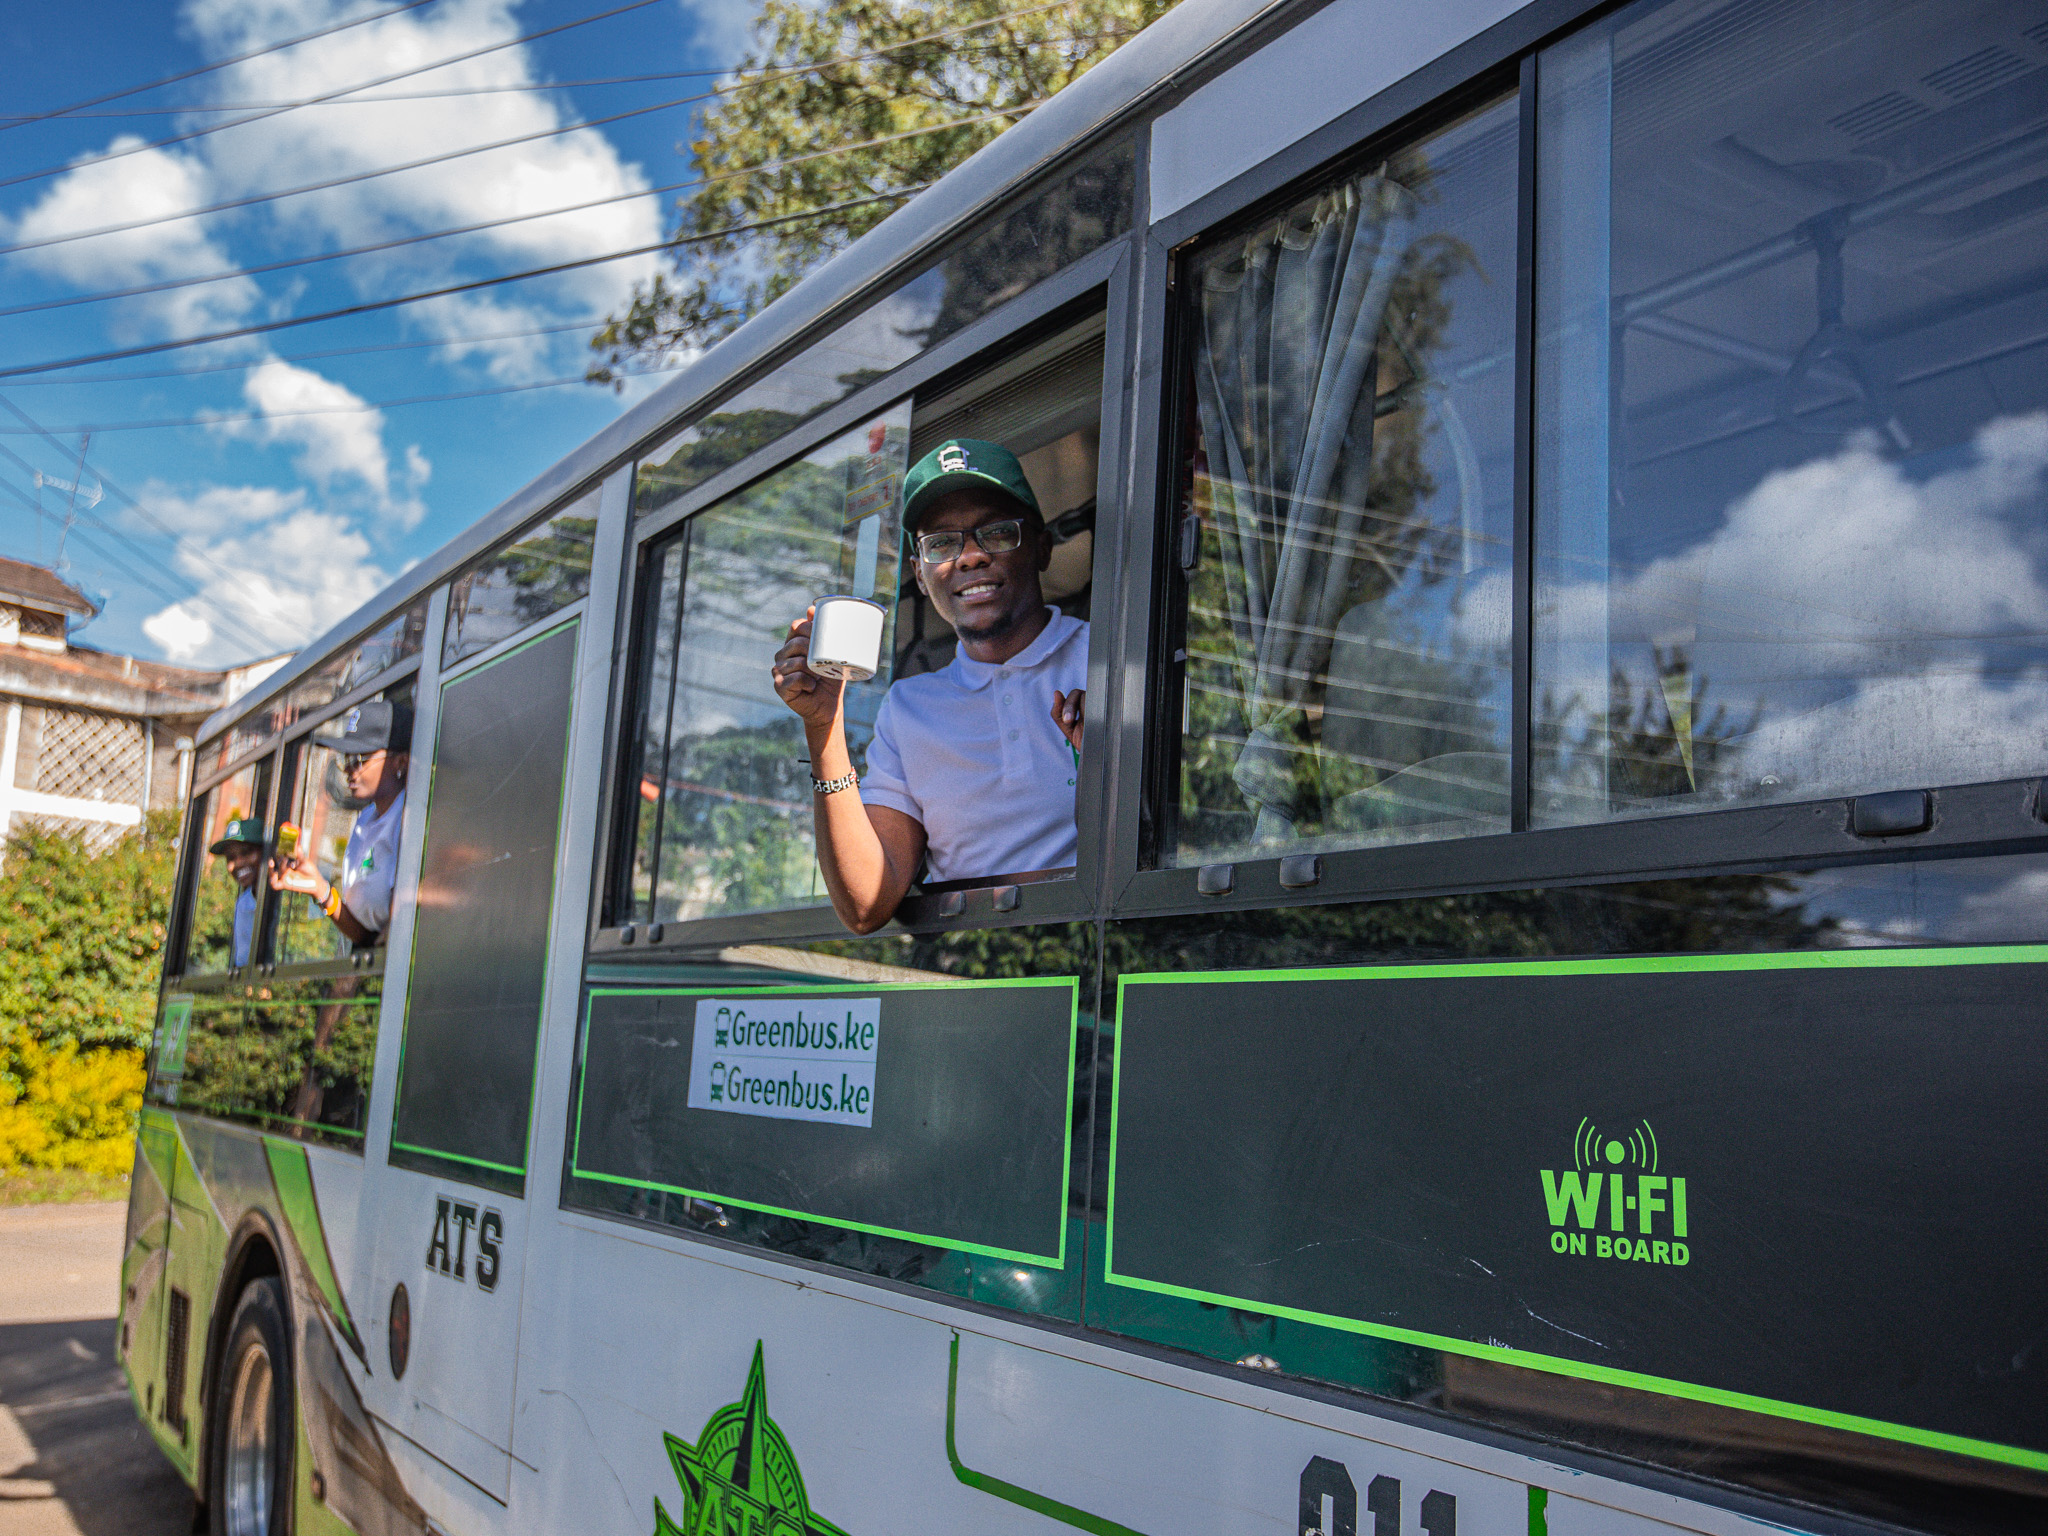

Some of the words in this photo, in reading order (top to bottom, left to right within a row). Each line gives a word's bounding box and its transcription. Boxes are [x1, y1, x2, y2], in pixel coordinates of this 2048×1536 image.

[732, 1010, 875, 1051] Greenbus.ke
[727, 1066, 870, 1114] Greenbus.ke
[1540, 1169, 1688, 1238] WI-FI
[426, 1194, 505, 1294] ATS
[1550, 1231, 1587, 1256] ON
[1596, 1235, 1690, 1266] BOARD
